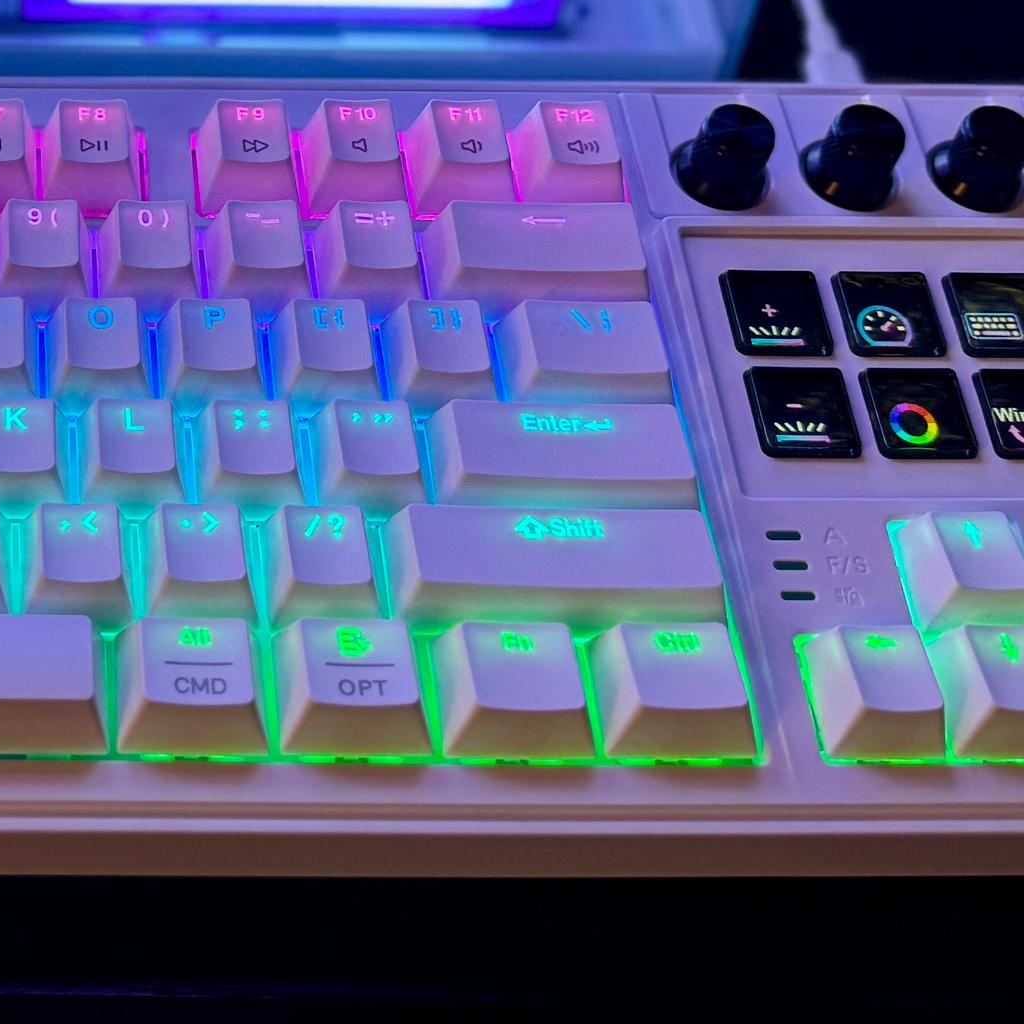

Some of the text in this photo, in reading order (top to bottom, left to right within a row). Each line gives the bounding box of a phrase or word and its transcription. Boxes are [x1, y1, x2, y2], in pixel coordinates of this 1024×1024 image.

[78, 107, 107, 121] F8
[236, 107, 265, 121] F9
[338, 106, 378, 121] F10
[448, 106, 484, 122] F11
[554, 108, 595, 123] F12
[88, 306, 114, 330] O
[203, 306, 226, 329] P
[3, 407, 28, 431] K
[125, 407, 145, 432] L
[520, 412, 582, 432] Enter
[549, 517, 604, 538] Shift
[824, 527, 847, 544] A
[826, 556, 870, 575] F/S
[500, 631, 535, 652] Fn
[174, 677, 226, 695] CMD
[338, 679, 387, 696] OPT
